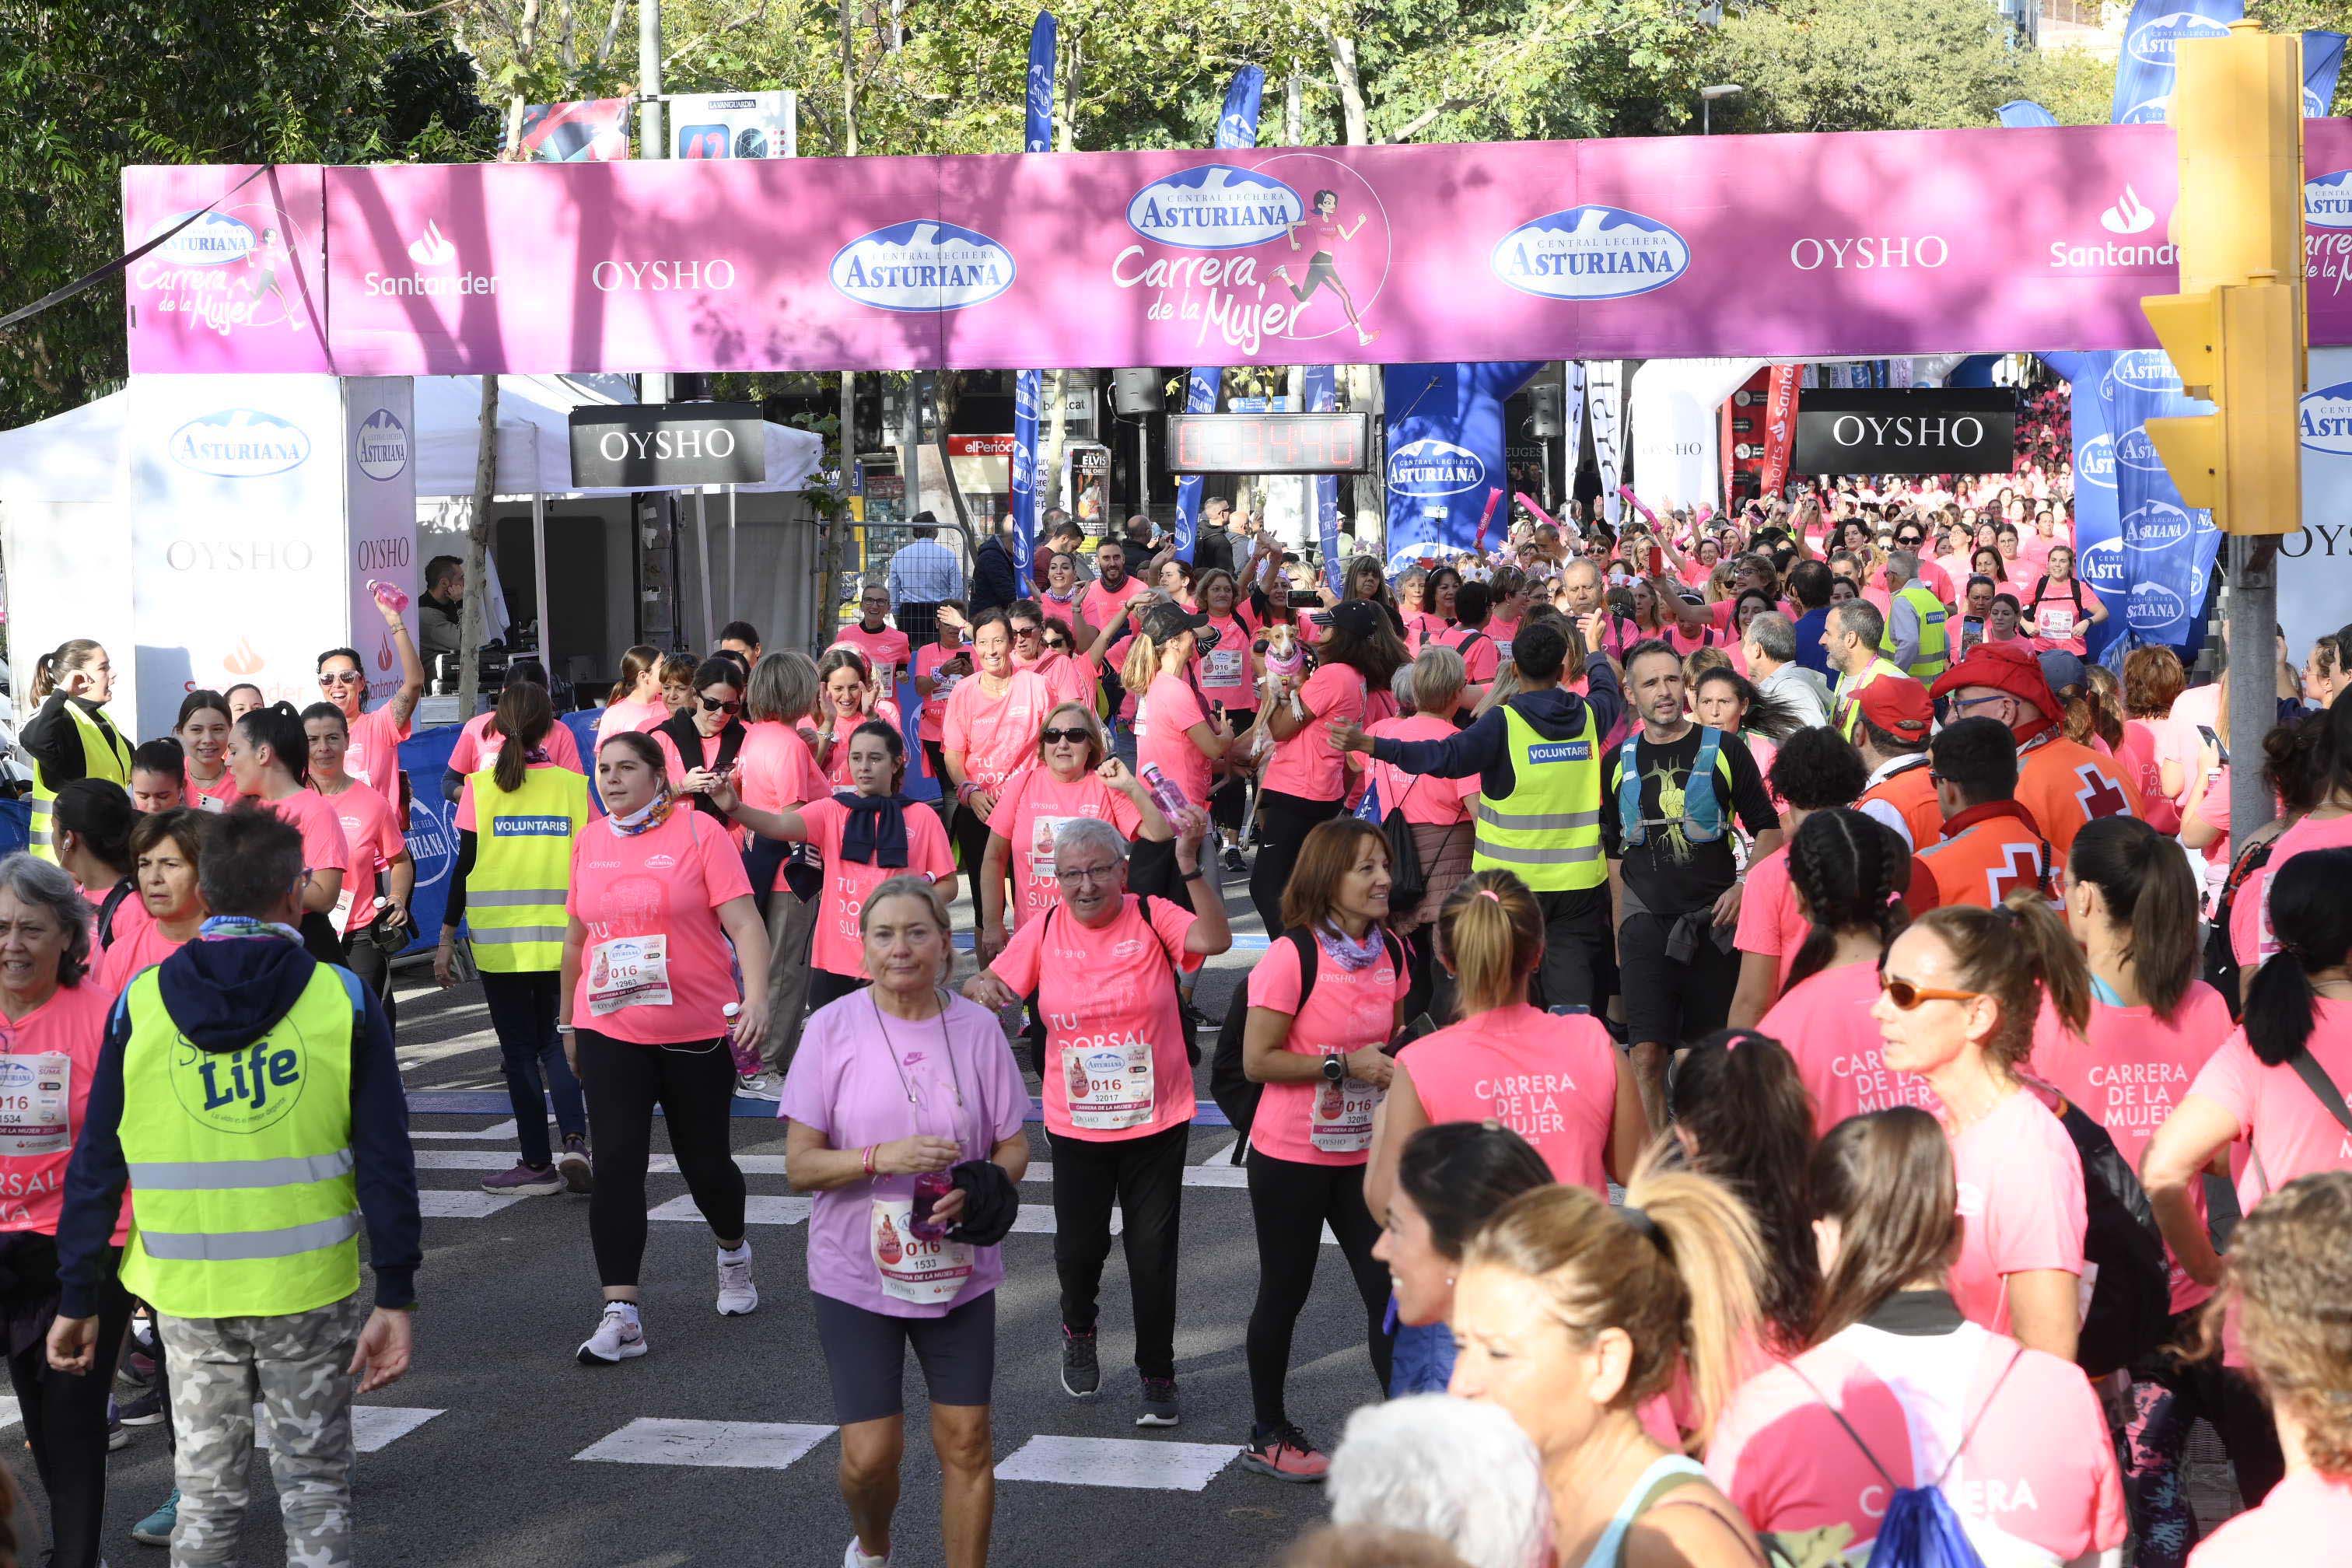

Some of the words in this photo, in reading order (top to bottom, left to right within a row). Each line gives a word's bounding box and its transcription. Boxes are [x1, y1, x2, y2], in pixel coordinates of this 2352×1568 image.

[1167, 194, 1223, 202] CENTRAL
[1228, 192, 1285, 202] LECHERA
[1140, 196, 1290, 228] ASTURIANA
[1537, 238, 1598, 249] CENTRAL
[1605, 236, 1668, 248] LECHERA
[1790, 236, 1948, 270] OYSHO
[2050, 241, 2179, 268] Santand
[872, 250, 931, 261] CENTRAL
[936, 249, 996, 261] LECHERA
[1112, 245, 1257, 288] Carrera
[1507, 241, 1674, 277] ASTURIANA
[136, 261, 226, 290] Carrera
[591, 258, 735, 292] OYSHO
[844, 253, 1002, 289] ASTURIANA
[364, 271, 500, 297] Santander
[159, 293, 175, 312] de
[179, 291, 192, 312] la
[190, 287, 261, 336] Mujer
[1147, 291, 1174, 321] de
[1181, 291, 1200, 320] la
[1196, 284, 1311, 356] Mujer
[1832, 415, 1984, 447] OYSHO
[181, 434, 300, 460] ASTURIANA
[360, 443, 405, 463] ASTURIANA
[599, 428, 735, 461] OYSHO
[1083, 455, 1106, 465] ELVIS
[1388, 466, 1479, 484] ASTURIANA
[166, 540, 313, 572] OYSHO
[358, 536, 410, 572] OYSHO
[975, 758, 993, 768] TU
[1530, 745, 1589, 760] VOLUNTARIS
[495, 820, 568, 833] VOLUNTARIS
[837, 877, 856, 894] TU
[587, 921, 609, 939] TU
[611, 965, 638, 978] 016
[615, 978, 637, 989] 12963
[1050, 1013, 1078, 1031] TU
[198, 1042, 299, 1111] Life
[1091, 1079, 1122, 1091] 016
[1475, 1073, 1577, 1101] CARRERA
[1857, 1072, 1888, 1094] DE
[2088, 1063, 2189, 1087] CARRERA
[1346, 1099, 1371, 1113] 016
[1496, 1097, 1524, 1118] DE
[1530, 1094, 1559, 1115] LA
[2108, 1086, 2138, 1105] DE
[2144, 1085, 2171, 1104] LA
[914, 1259, 937, 1270] 1533
